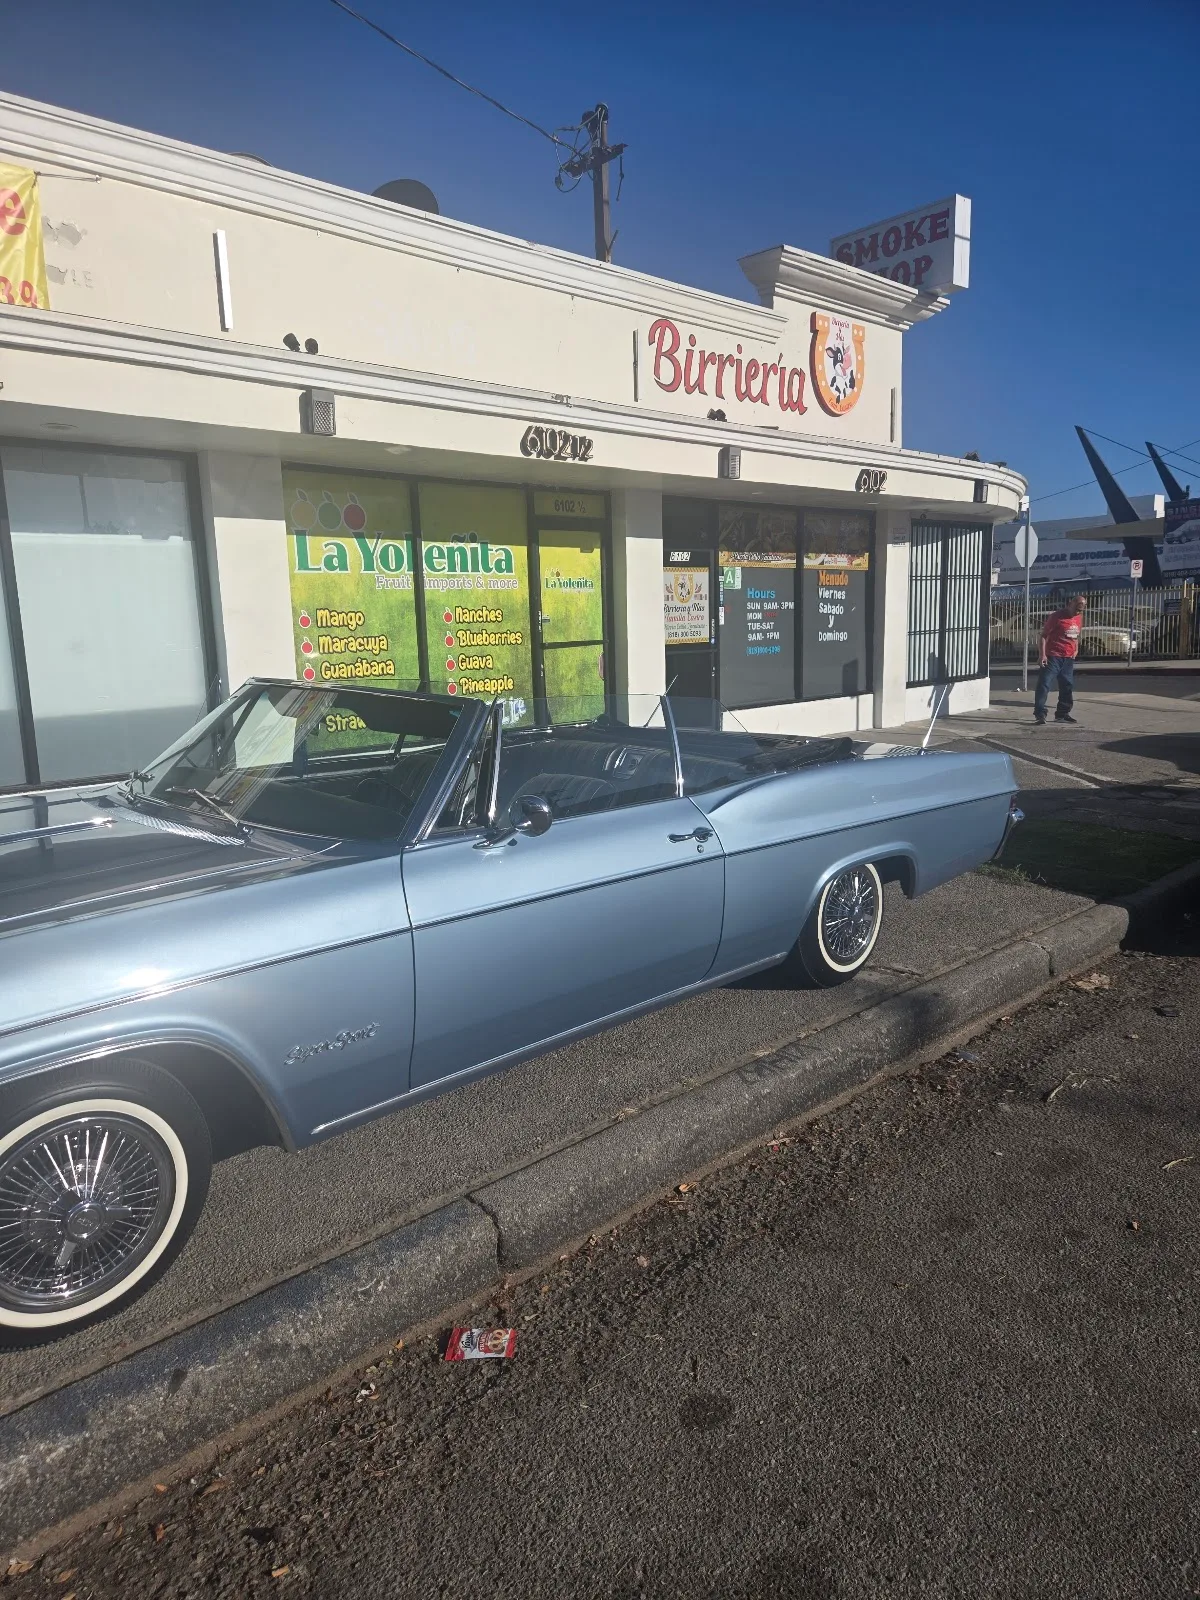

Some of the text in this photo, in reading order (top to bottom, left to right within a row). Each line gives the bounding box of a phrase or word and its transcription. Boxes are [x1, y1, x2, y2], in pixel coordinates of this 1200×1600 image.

[836, 207, 950, 267] SMOKE
[648, 318, 808, 415] Birriería
[855, 469, 887, 492] 6102
[554, 499, 576, 513] 6102
[294, 528, 350, 573] La
[670, 552, 690, 561] 6102
[375, 574, 411, 589] Fruit
[475, 576, 486, 590] &
[488, 578, 519, 591] more
[545, 577, 594, 589] La Yoleñita
[725, 571, 734, 584] A
[818, 570, 849, 586] Menudo
[747, 588, 776, 599] Hours
[818, 587, 846, 600] Viernes
[747, 602, 760, 610] SUN
[818, 603, 844, 615] Sabado
[316, 608, 365, 631] Mango
[455, 606, 503, 624] Nanches
[747, 612, 762, 620] MON
[747, 622, 774, 630] TUE-SAT
[456, 629, 523, 647] Blueberries
[818, 630, 848, 641] Domingo
[318, 634, 388, 656] Maracuya
[320, 656, 395, 680] Guanábana
[458, 653, 494, 671] Guava
[459, 674, 514, 695] Pineapple
